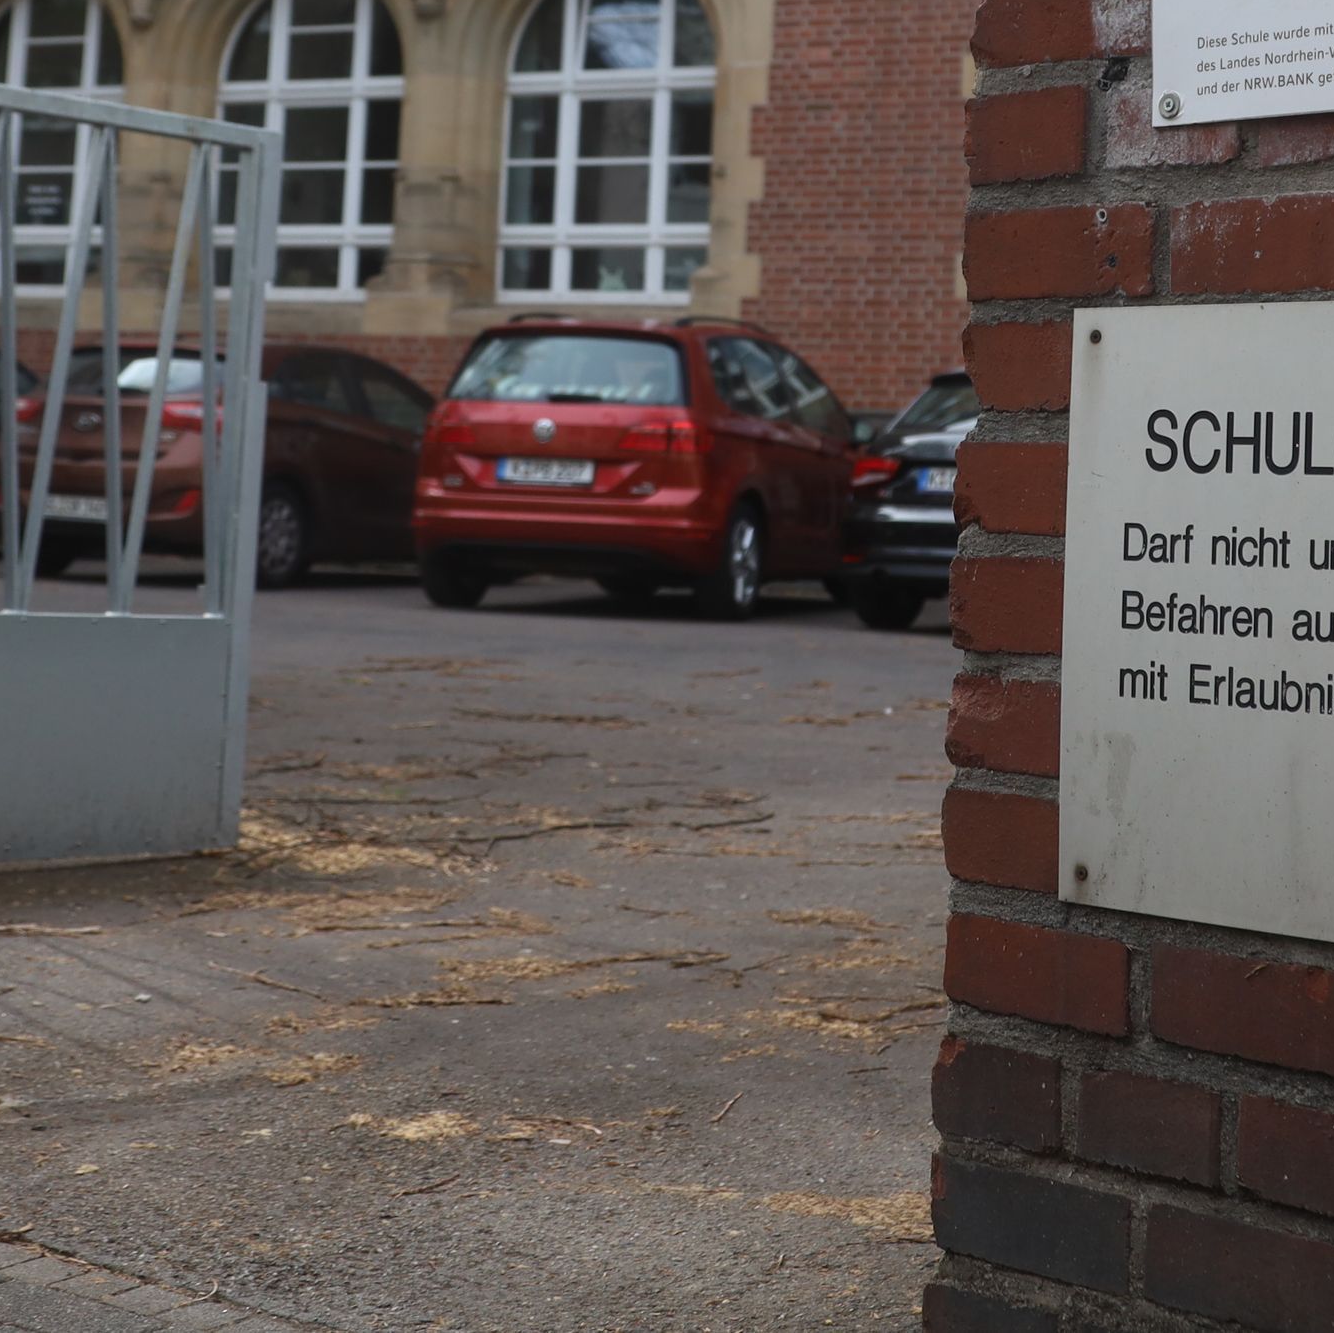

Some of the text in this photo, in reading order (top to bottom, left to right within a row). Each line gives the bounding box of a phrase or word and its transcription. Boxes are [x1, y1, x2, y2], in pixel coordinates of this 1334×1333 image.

[1197, 36, 1228, 50] Diese
[1231, 28, 1270, 46] Schule
[1273, 25, 1311, 41] wurde
[1314, 22, 1334, 36] mit
[1197, 58, 1217, 73] des
[1220, 53, 1261, 70] Landes
[1197, 81, 1218, 96] und
[1221, 79, 1241, 93] der
[1244, 71, 1315, 91] NRW.BANK
[1123, 522, 1194, 564] Darf
[1211, 526, 1290, 569] nicht
[1121, 589, 1273, 639] Befahren
[1119, 660, 1168, 702] mit
